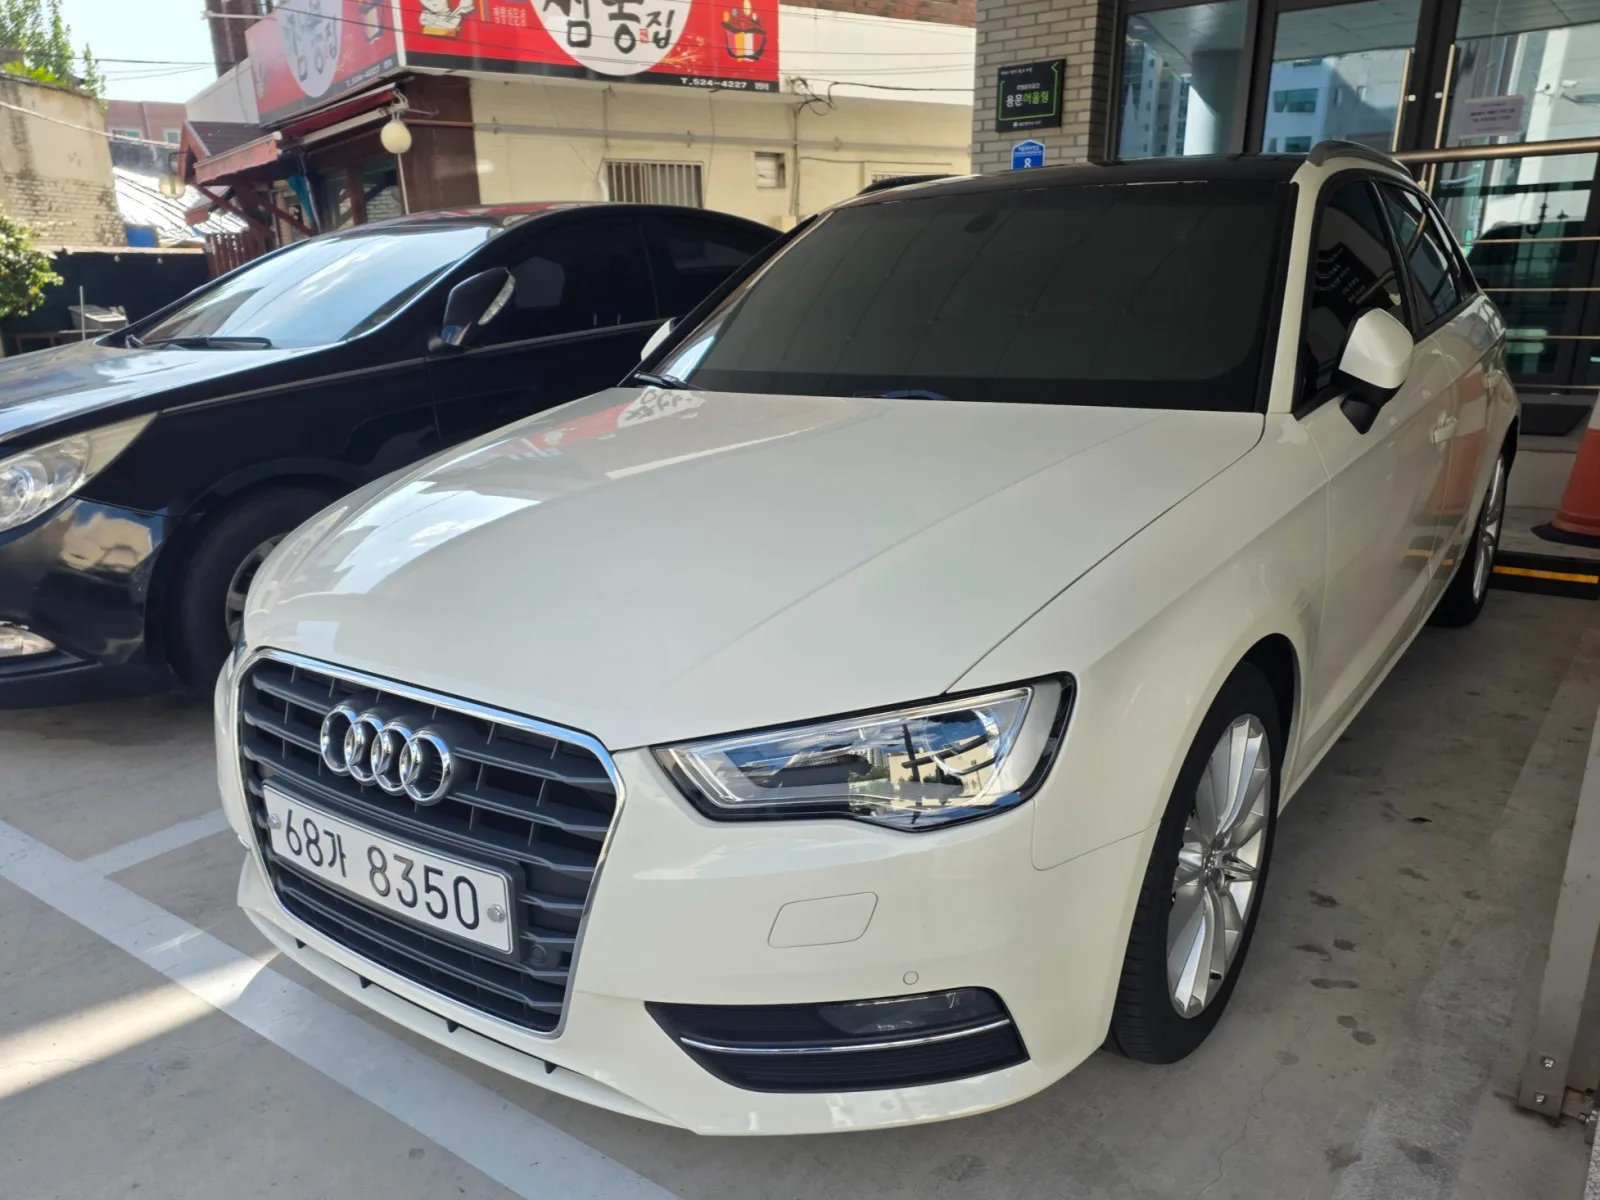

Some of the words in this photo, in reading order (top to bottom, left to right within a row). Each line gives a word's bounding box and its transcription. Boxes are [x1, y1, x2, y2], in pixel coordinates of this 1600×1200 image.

[680, 77, 748, 89] T.524-4227
[285, 809, 348, 879] 68가
[366, 845, 480, 931] 8350
